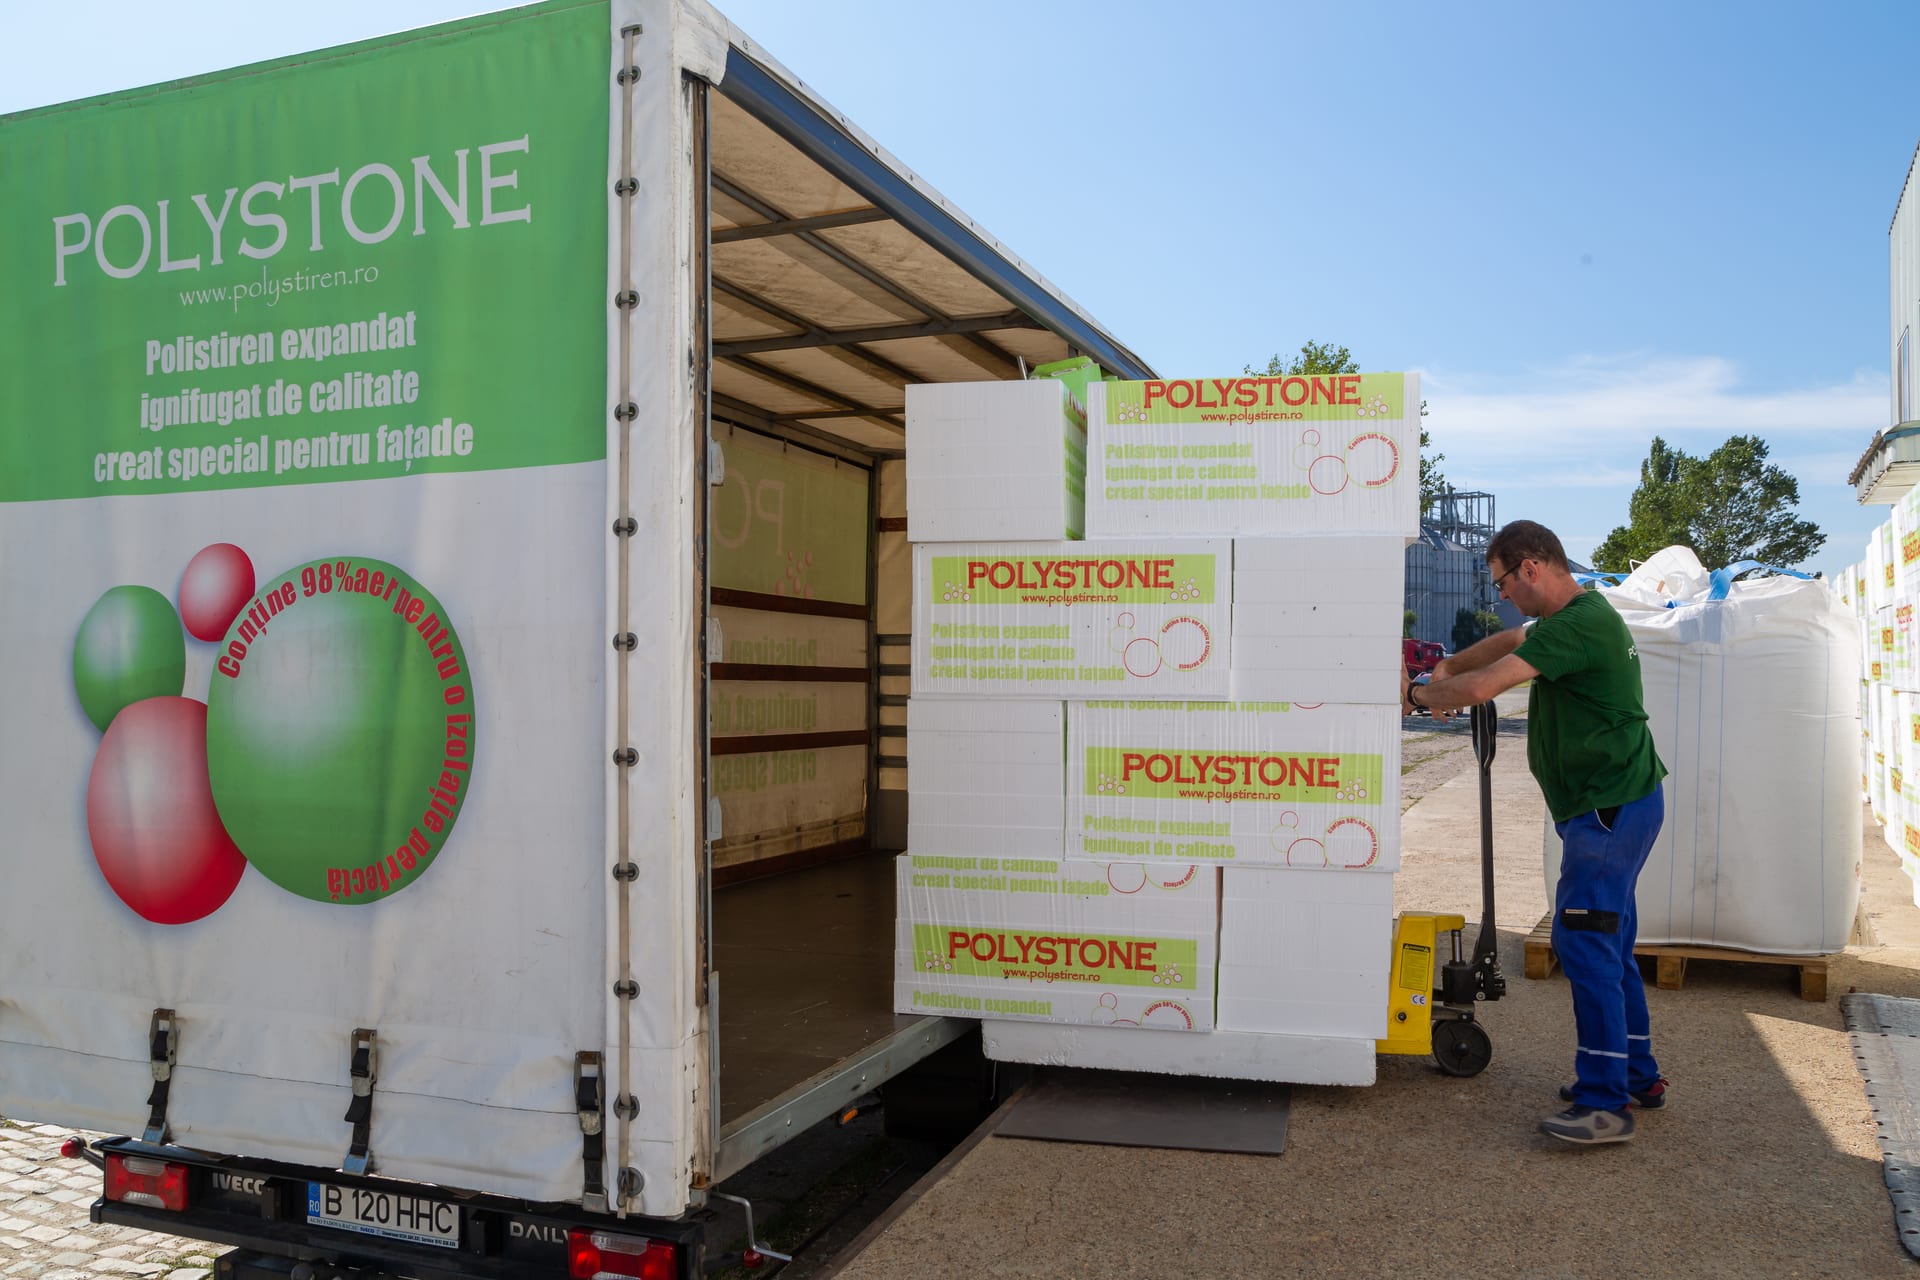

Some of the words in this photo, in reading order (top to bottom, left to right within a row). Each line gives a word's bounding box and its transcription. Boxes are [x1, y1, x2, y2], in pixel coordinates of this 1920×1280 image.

[53, 134, 531, 287] POLYSTONE
[179, 265, 380, 313] www.polystiren.ro
[145, 328, 275, 376] Polistiren
[280, 310, 417, 363] expandat
[140, 380, 262, 432] ignifugat
[266, 379, 303, 417] de
[309, 370, 419, 414] calitate
[1144, 375, 1361, 409] POLYSTONE
[1201, 408, 1303, 426] www.polystiren.ro
[94, 442, 164, 483] creat
[168, 435, 269, 482] special
[274, 431, 370, 475] pentru
[1105, 443, 1178, 459] Polistiren
[1181, 442, 1253, 461] expandat
[1176, 464, 1195, 480] de
[1199, 464, 1257, 480] calitate
[1105, 485, 1144, 500] creat
[1147, 484, 1203, 501] special
[1206, 485, 1258, 501] pentru
[968, 559, 1174, 589] POLYSTONE
[1021, 590, 1119, 607] www.polystiren.ro
[931, 623, 999, 639] Polistiren
[1002, 624, 1070, 640] expandat
[392, 586, 461, 680] pentru
[444, 685, 465, 706] o
[997, 644, 1016, 660] de
[1018, 645, 1075, 660] calitate
[930, 664, 968, 679] creat
[970, 665, 1024, 681] special
[1026, 666, 1075, 682] pentru
[1122, 753, 1340, 788] POLYSTONE
[1179, 785, 1281, 804] www.polystiren.ro
[1083, 814, 1156, 834] Polistiren
[1159, 819, 1231, 837] expandat
[1083, 835, 1151, 856] ignifugat
[1153, 839, 1173, 856] de
[1176, 841, 1235, 859] calitate
[912, 873, 950, 888] creat
[953, 874, 1007, 891] special
[1010, 877, 1058, 893] pentru
[948, 931, 1157, 972] POLYSTONE
[1002, 966, 1100, 983] www.polystiren.ro
[913, 990, 981, 1011] Polistiren
[984, 998, 1052, 1015] expandat
[309, 1200, 320, 1212] RO
[326, 1185, 342, 1216] B
[352, 1189, 390, 1224] 120
[397, 1195, 453, 1234] HHC
